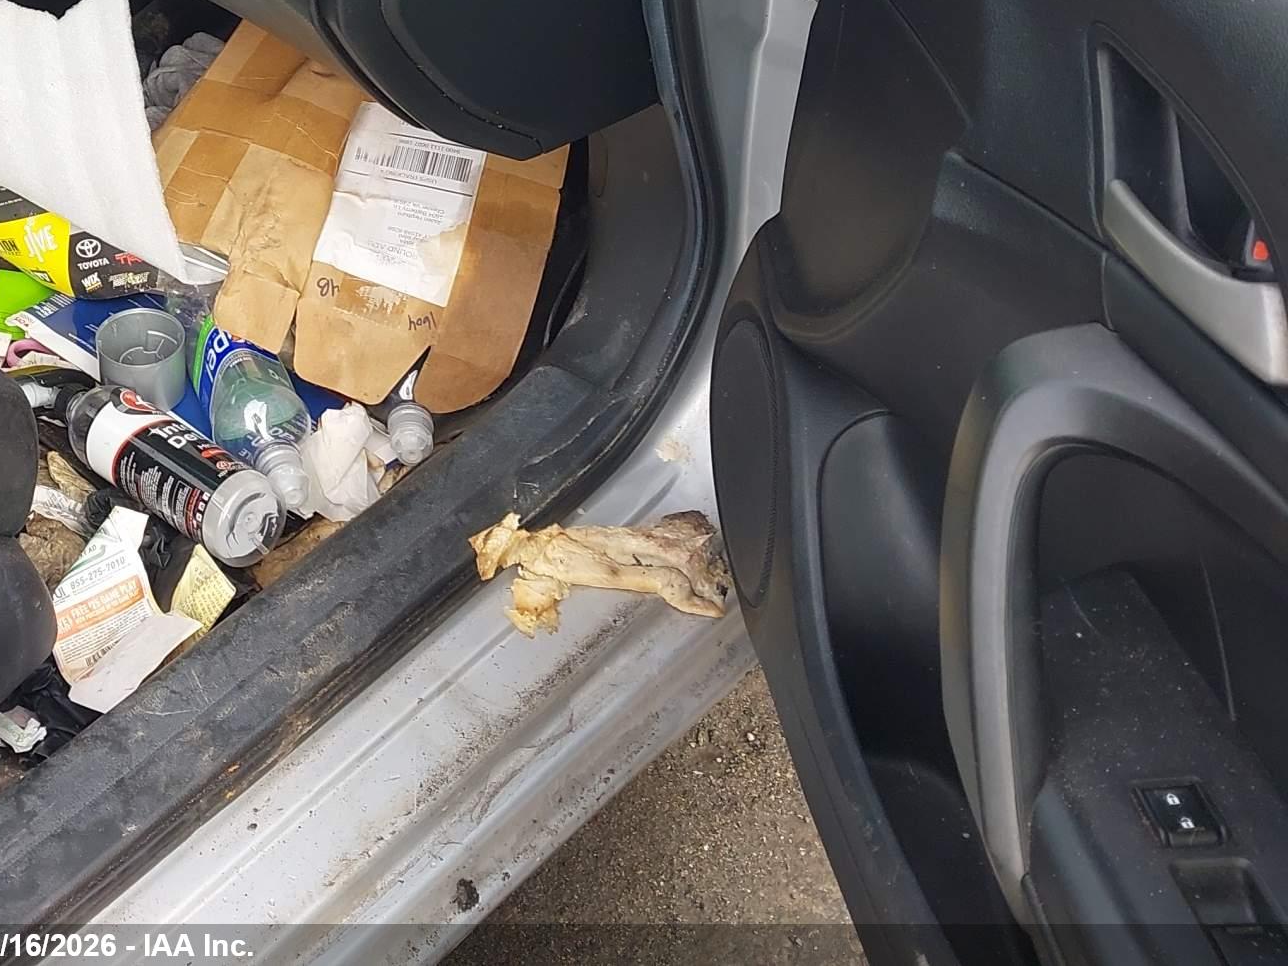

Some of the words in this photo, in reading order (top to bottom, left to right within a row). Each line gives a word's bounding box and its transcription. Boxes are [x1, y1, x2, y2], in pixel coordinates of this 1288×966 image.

[77, 258, 110, 270] TOYOTA
[81, 272, 101, 287] WIX
[408, 311, 438, 331] 1604
